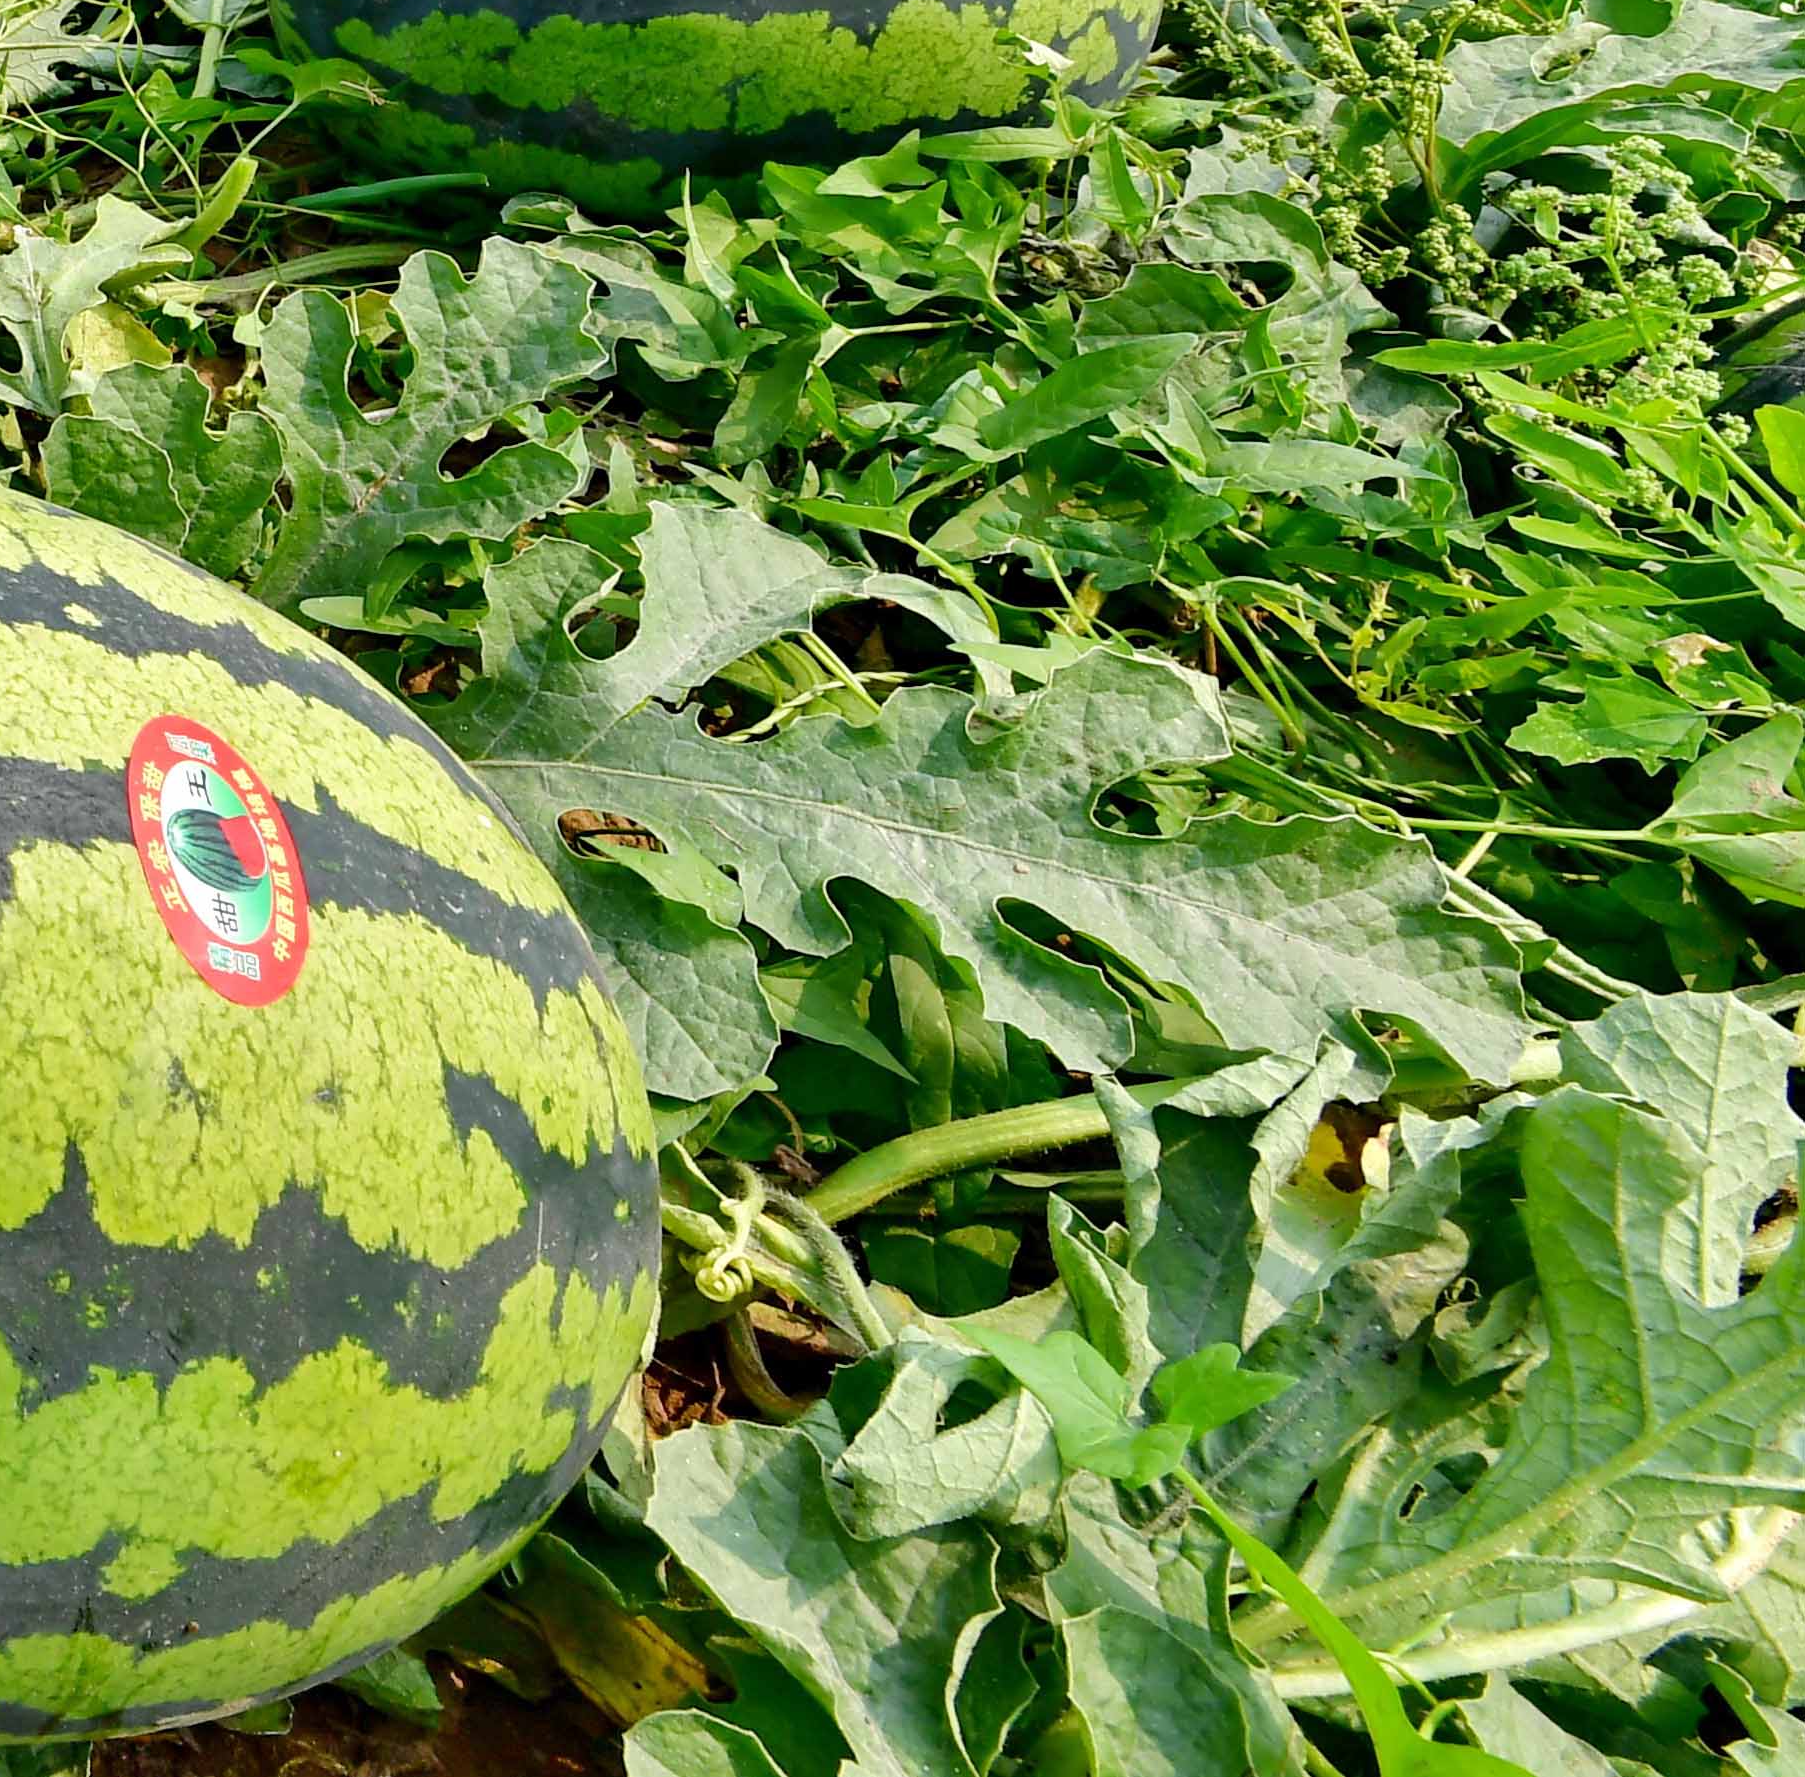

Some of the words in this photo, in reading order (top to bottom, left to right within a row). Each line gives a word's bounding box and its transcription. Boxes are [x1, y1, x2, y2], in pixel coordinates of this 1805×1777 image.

[186, 769, 212, 807] 王
[211, 893, 238, 935] 甜
[207, 941, 260, 981] 精品
